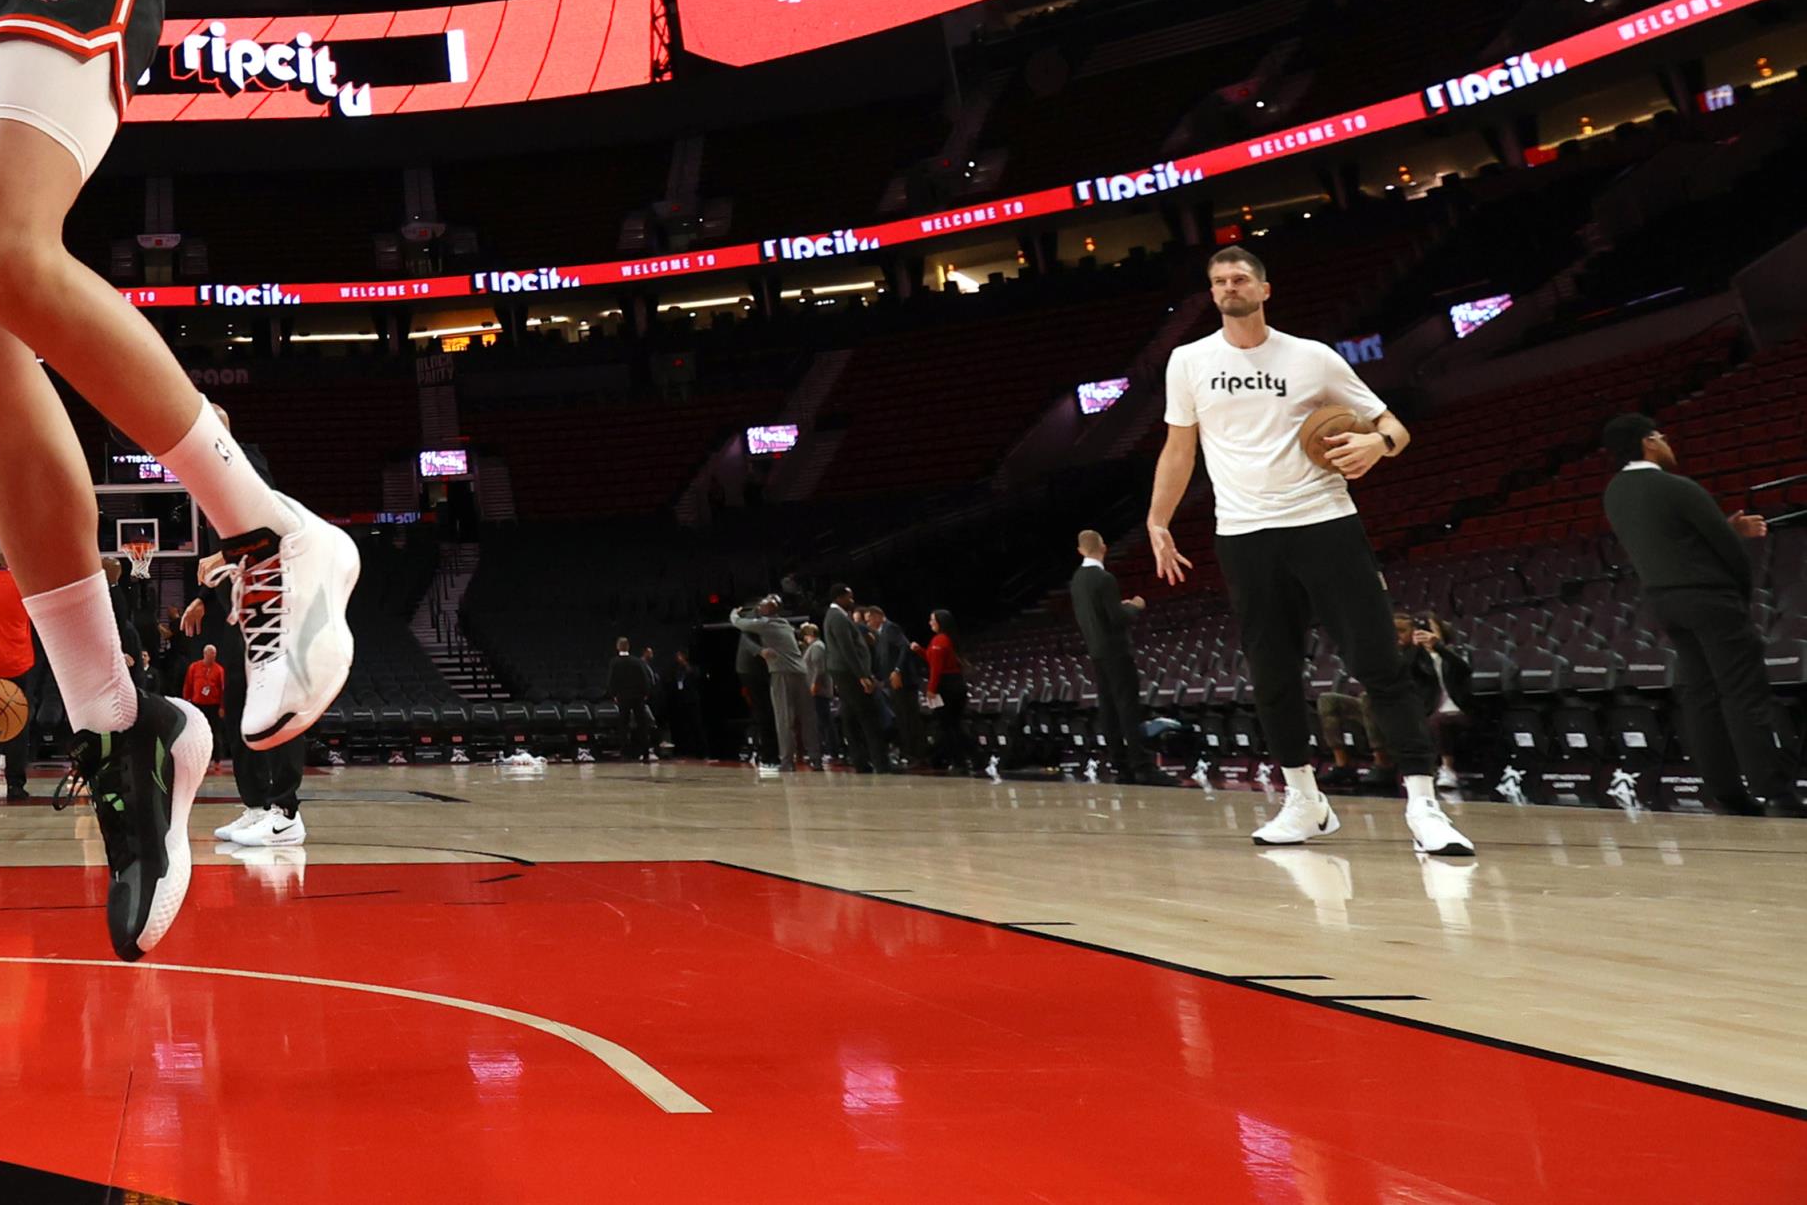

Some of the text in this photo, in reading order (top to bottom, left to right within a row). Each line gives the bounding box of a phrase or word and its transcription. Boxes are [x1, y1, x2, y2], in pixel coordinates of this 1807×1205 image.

[1248, 114, 1367, 159] WELCOME TO
[920, 200, 1024, 233] WELCOME TO
[620, 254, 716, 277] WELCOME TO
[139, 291, 156, 303] TO
[339, 283, 430, 298] WELCOME TO
[1210, 370, 1288, 397] ripcity
